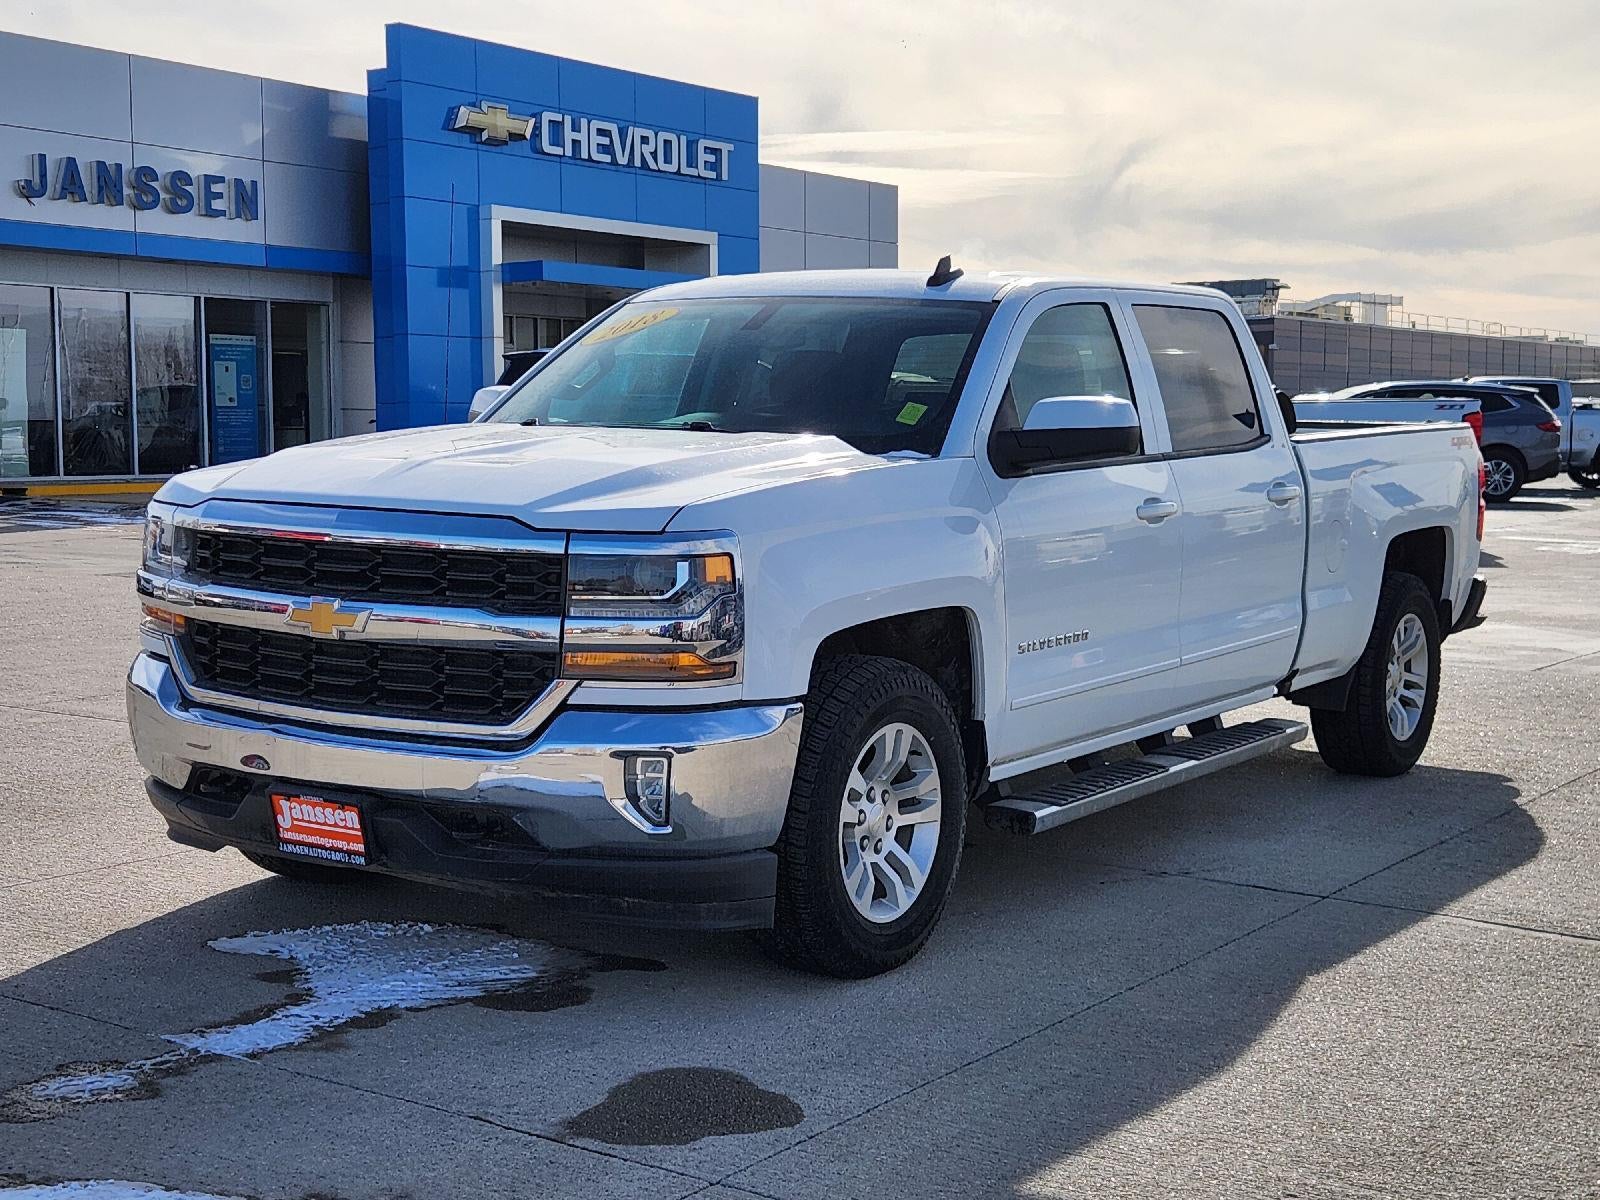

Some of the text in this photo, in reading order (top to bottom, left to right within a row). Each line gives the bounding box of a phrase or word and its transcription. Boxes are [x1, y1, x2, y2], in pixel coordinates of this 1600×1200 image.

[540, 111, 735, 181] CHEVROLET
[16, 152, 259, 221] JANSSEN
[1017, 629, 1090, 655] SILVERADO
[276, 799, 361, 829] Janssen
[278, 827, 365, 853] Janssenautogroup.com
